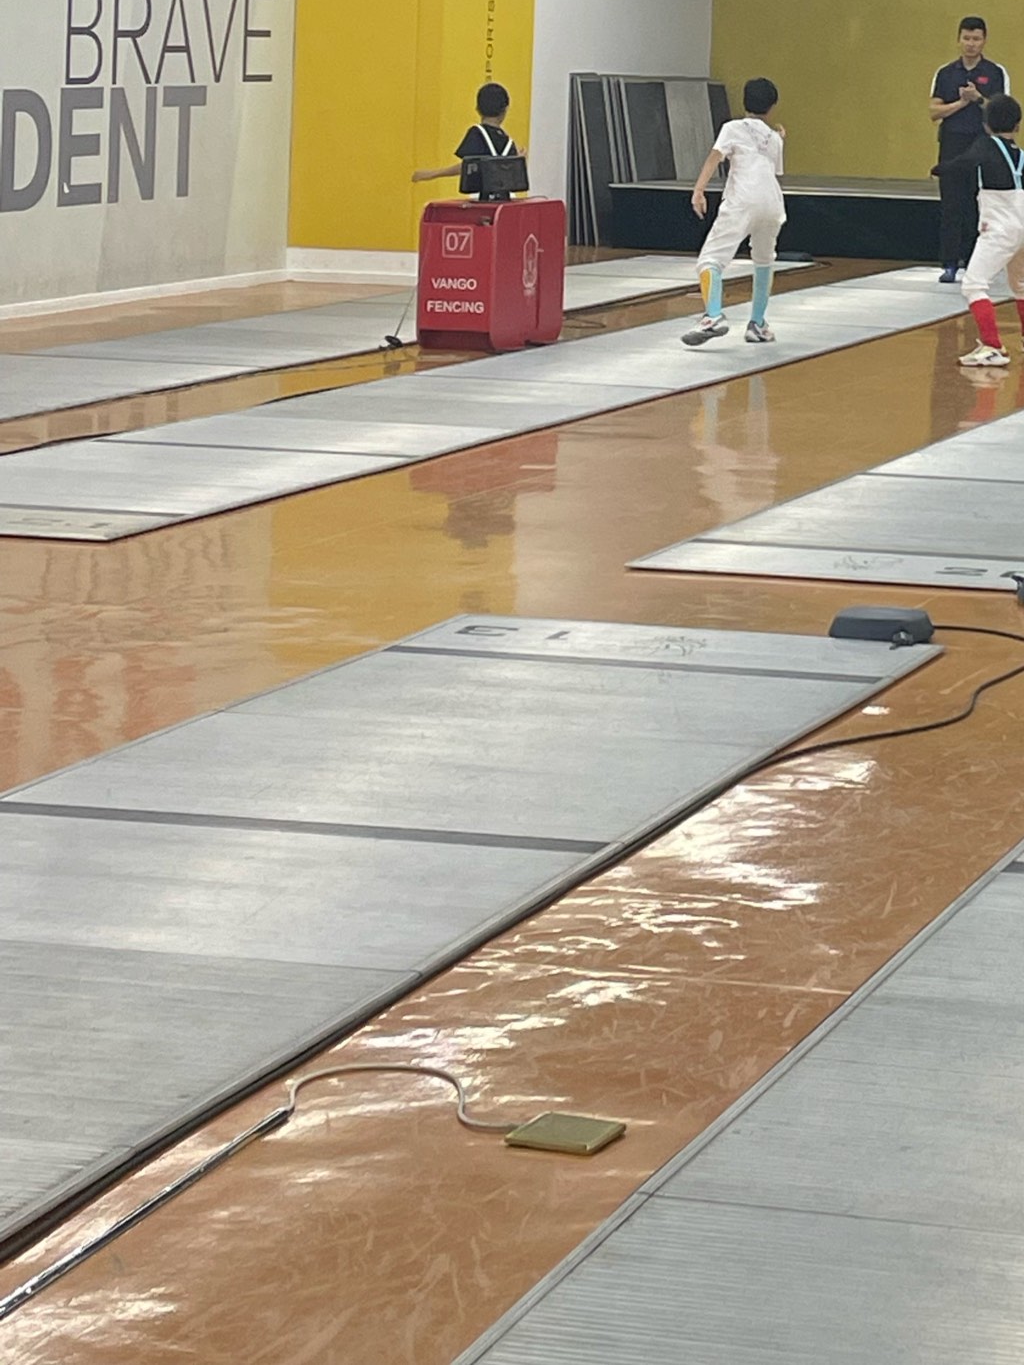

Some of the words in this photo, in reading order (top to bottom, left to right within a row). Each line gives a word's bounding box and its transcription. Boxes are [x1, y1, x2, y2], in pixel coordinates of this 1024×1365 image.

[0, 85, 207, 213] DENT
[445, 232, 470, 251] 07
[431, 278, 477, 290] VANGO
[426, 300, 484, 314] FENCING
